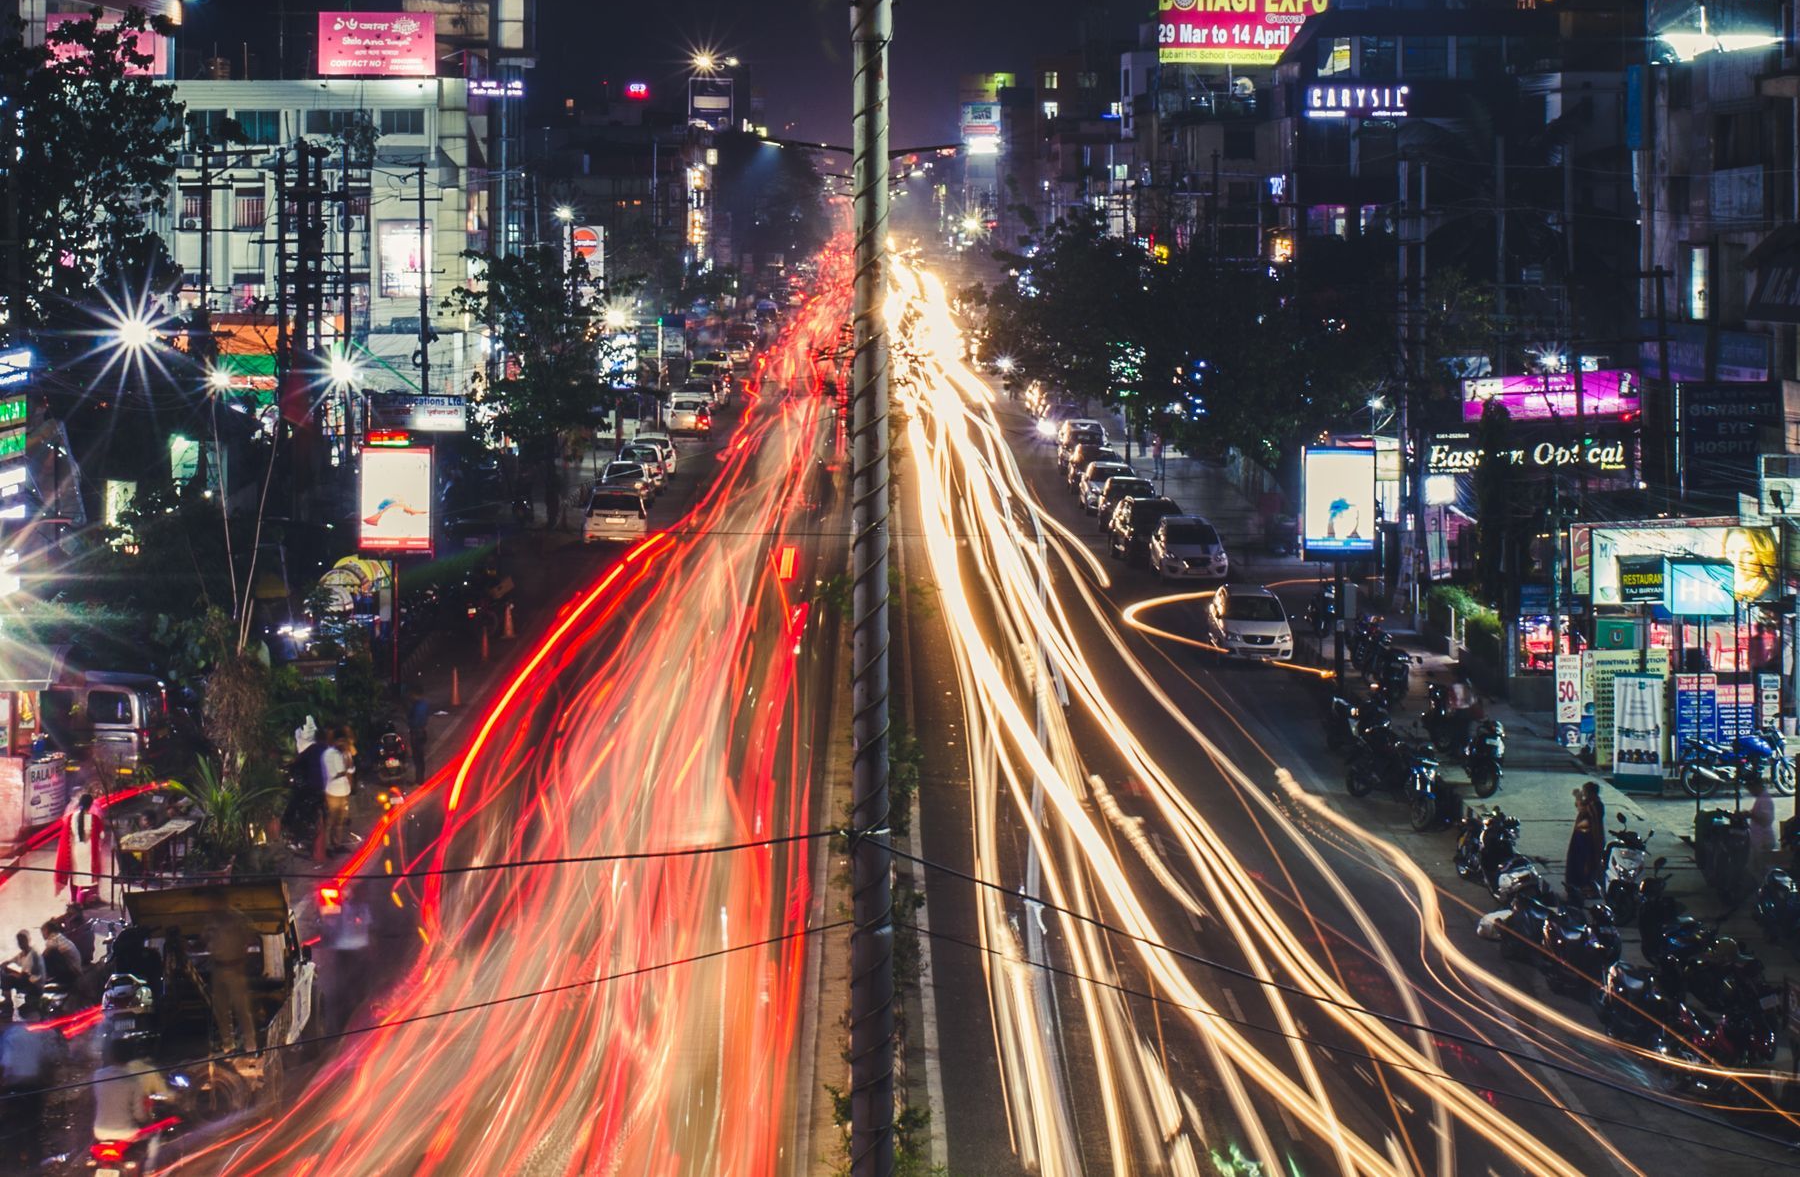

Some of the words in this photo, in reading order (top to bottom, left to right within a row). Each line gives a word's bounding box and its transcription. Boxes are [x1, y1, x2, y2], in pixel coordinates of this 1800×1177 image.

[1158, 23, 1175, 44] 29
[1179, 24, 1208, 45] Mar
[1211, 25, 1229, 44] to
[1232, 25, 1251, 45] 14
[1253, 24, 1290, 49] April
[1199, 51, 1225, 60] School
[330, 59, 368, 68] CONTACT
[1312, 87, 1406, 108] CARYSIL
[447, 396, 465, 406] Ltd.
[1689, 402, 1776, 417] GUWAHATI
[1717, 422, 1748, 435] EYE
[1596, 659, 1630, 667] PRINTING
